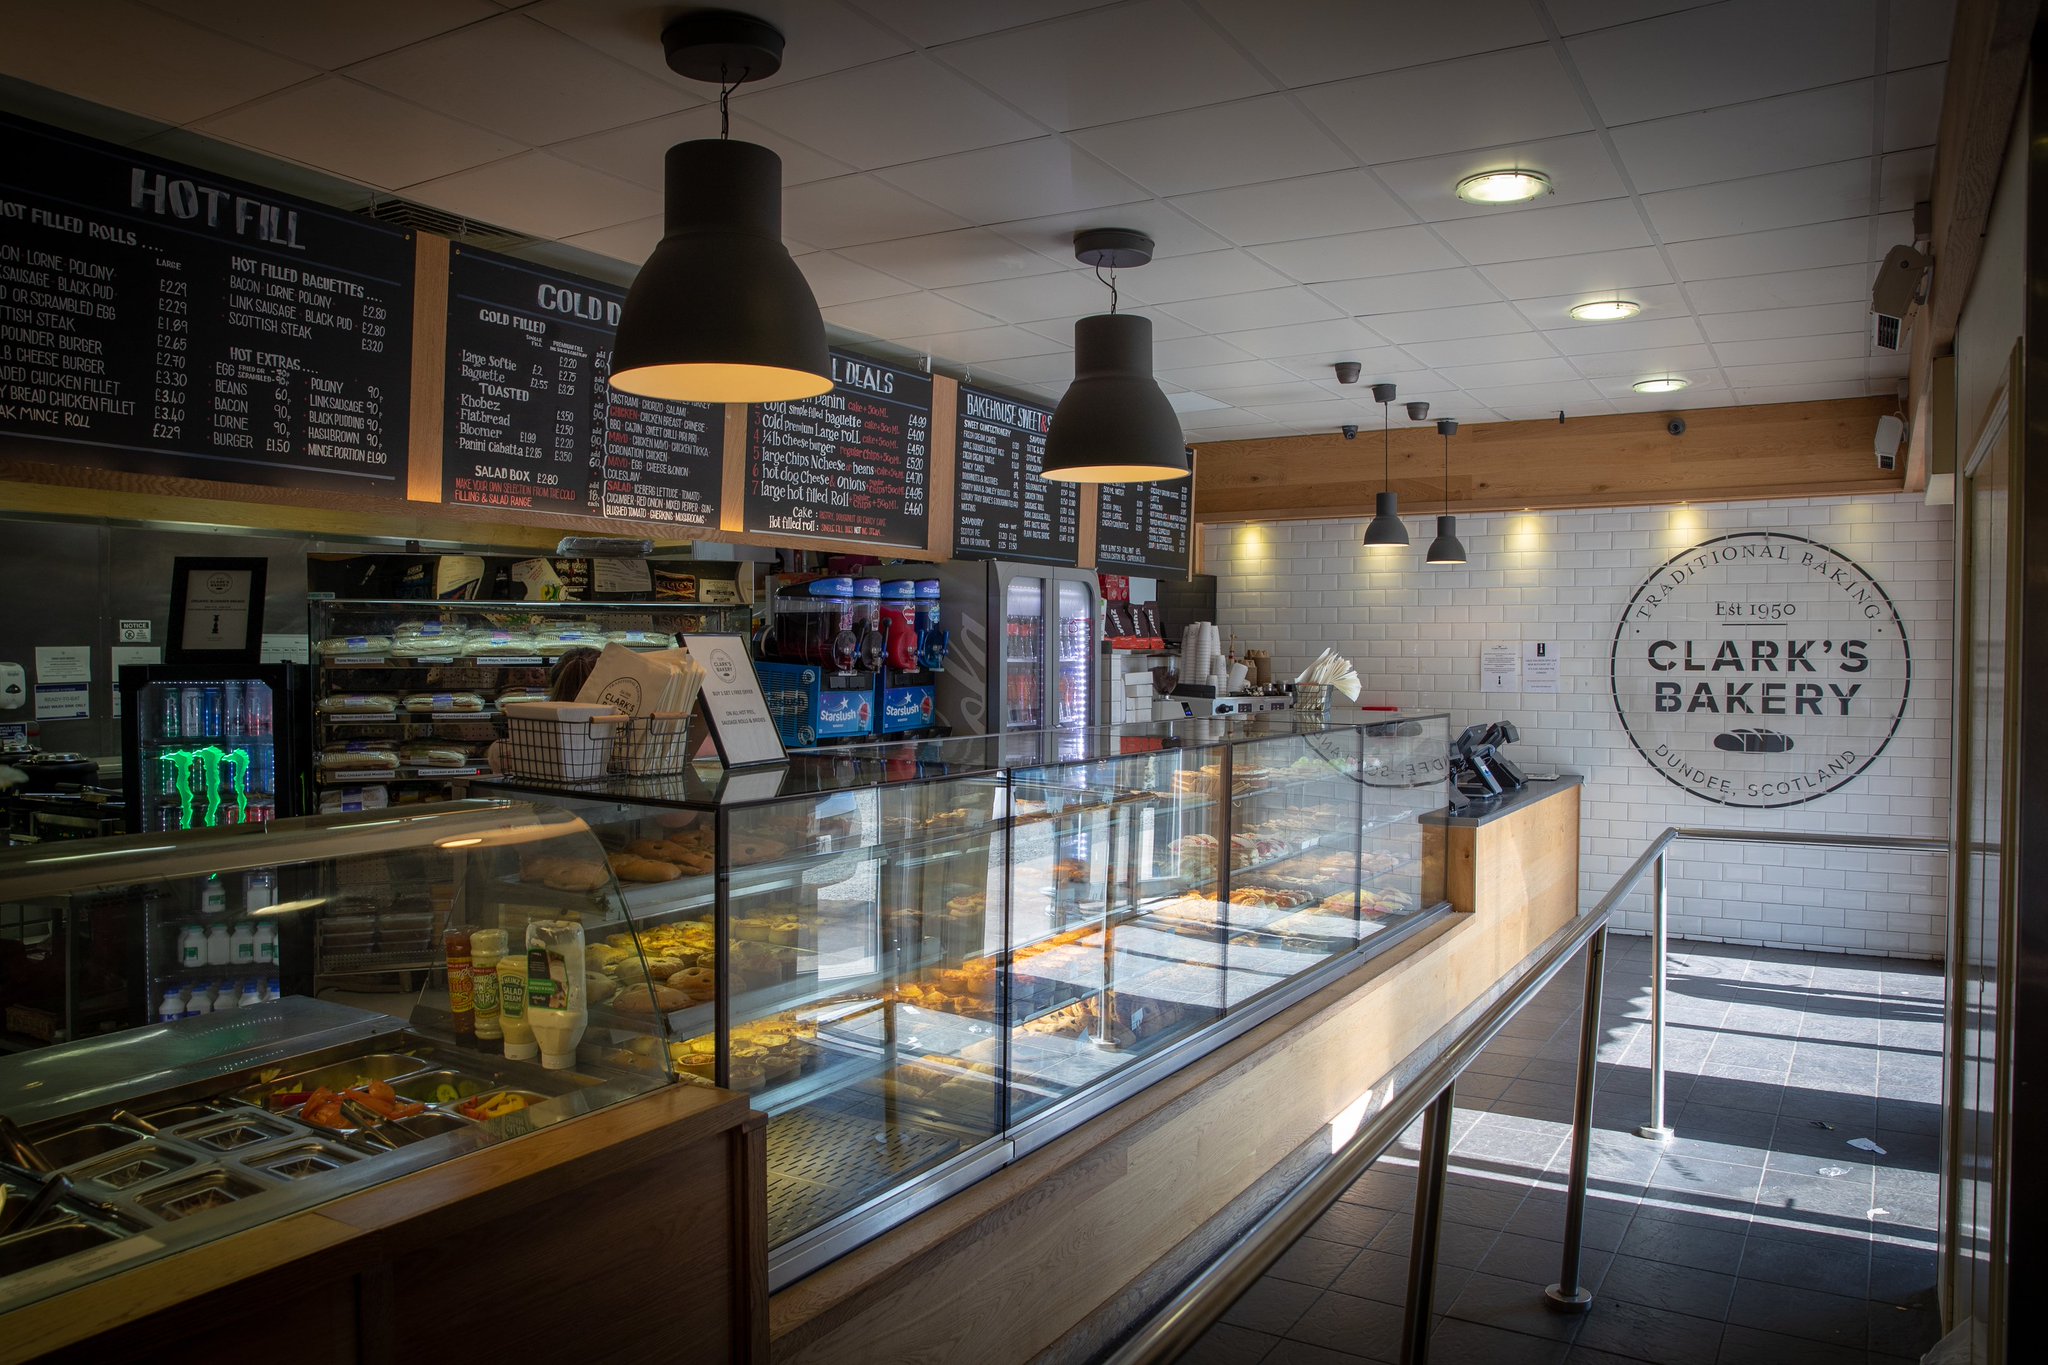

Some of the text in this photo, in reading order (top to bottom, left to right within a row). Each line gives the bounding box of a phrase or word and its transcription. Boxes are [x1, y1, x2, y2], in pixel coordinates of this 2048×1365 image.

[131, 168, 306, 250] HOT FILL
[31, 207, 137, 246] FILLED ROLLS
[27, 250, 63, 272] LORNE
[69, 258, 115, 281] POLONY
[156, 258, 182, 271] LARGE
[2, 266, 114, 300] SAUSAGE BLACK PUD
[231, 256, 365, 299] HOT FILLED BAGUETTES
[230, 275, 333, 309] BACON LORNE POLONY
[538, 283, 602, 321] COLD
[12, 288, 28, 304] OR
[30, 292, 93, 317] SCRAMBLED
[96, 304, 117, 320] EGG
[229, 293, 353, 331] LINK SAUSAGE BLACK PUD
[36, 311, 77, 332] STEAK
[229, 312, 312, 340] SCOTTISH STEAK
[479, 309, 547, 335] COLD FILLED
[2, 324, 103, 355] POUNDER BURGER
[16, 347, 59, 368] CHEESE
[62, 355, 106, 375] BURGER
[216, 361, 235, 377] EGG
[230, 346, 301, 371] HOT EXTRAS
[461, 349, 517, 372] Large Softie
[30, 371, 82, 391] CHICKEN
[83, 380, 120, 396] FILLET
[461, 364, 506, 385] Baguette
[845, 360, 894, 394] DEALS
[215, 379, 248, 396] BEANS
[310, 377, 344, 394] POLONY
[479, 383, 530, 402] TOASTED
[10, 385, 136, 416] BREAD CHICKEN FILLET
[214, 397, 249, 413] BACON
[309, 394, 365, 414] LINK SAUSAGE
[461, 393, 501, 411] Khobez
[610, 393, 639, 409] PASTRAMI
[641, 399, 663, 412] CHORIZO
[665, 404, 687, 417] SALAMI
[20, 406, 59, 424] MINCE
[64, 411, 91, 429] ROLL
[213, 414, 249, 431] LORNE
[309, 410, 365, 430] BLACK PUDDING
[460, 408, 511, 427] Flatbread
[640, 411, 706, 432] CHICKEN BREAST CHINESE
[825, 410, 862, 428] baguette
[966, 393, 1017, 426] BAKEHOUSE
[1017, 407, 1042, 433] SWEET
[460, 422, 503, 438] Bloomer
[624, 421, 642, 434] CAJUN
[815, 423, 839, 441] Large
[213, 432, 254, 449] BURGER
[459, 437, 524, 457] Panini Ciabatta
[608, 431, 709, 457] MAYO CHICKEN CHICKEN TIKKA
[809, 437, 836, 456] burger
[308, 444, 366, 463] MINCE PORTION
[609, 444, 668, 462] CORONATION CHICKEN
[761, 447, 785, 466] large
[785, 451, 811, 466] Chips
[852, 461, 874, 475] beans
[474, 465, 531, 482] SALAD BOX
[608, 468, 640, 482] COLESLAW
[631, 459, 668, 475] EGG CHEESE
[762, 463, 799, 485] hot dog
[455, 478, 533, 495] MAKE YOUR SELECTION
[607, 480, 678, 499] SALAD ICEBERG LETTUCE
[760, 481, 849, 507] large hot filled Roll
[455, 489, 532, 507] FILLING SALAD RANGE
[606, 492, 698, 513] CUCUMBER RED ONION MIXED PEPPER
[606, 505, 627, 517] BLUSHED
[628, 506, 646, 518] TOMATO
[1636, 544, 1881, 620] TRADITIONAL BAKING
[1714, 601, 1797, 620] Est 1950
[1647, 639, 1869, 673] CLARK'S
[605, 692, 636, 713] CLARK'S
[1655, 681, 1863, 716] BAKERY
[820, 709, 857, 722] Starslush
[885, 704, 919, 716] Starslush
[1655, 743, 1857, 797] DUNDEE, SCOTLAND
[503, 986, 523, 996] SALAD
